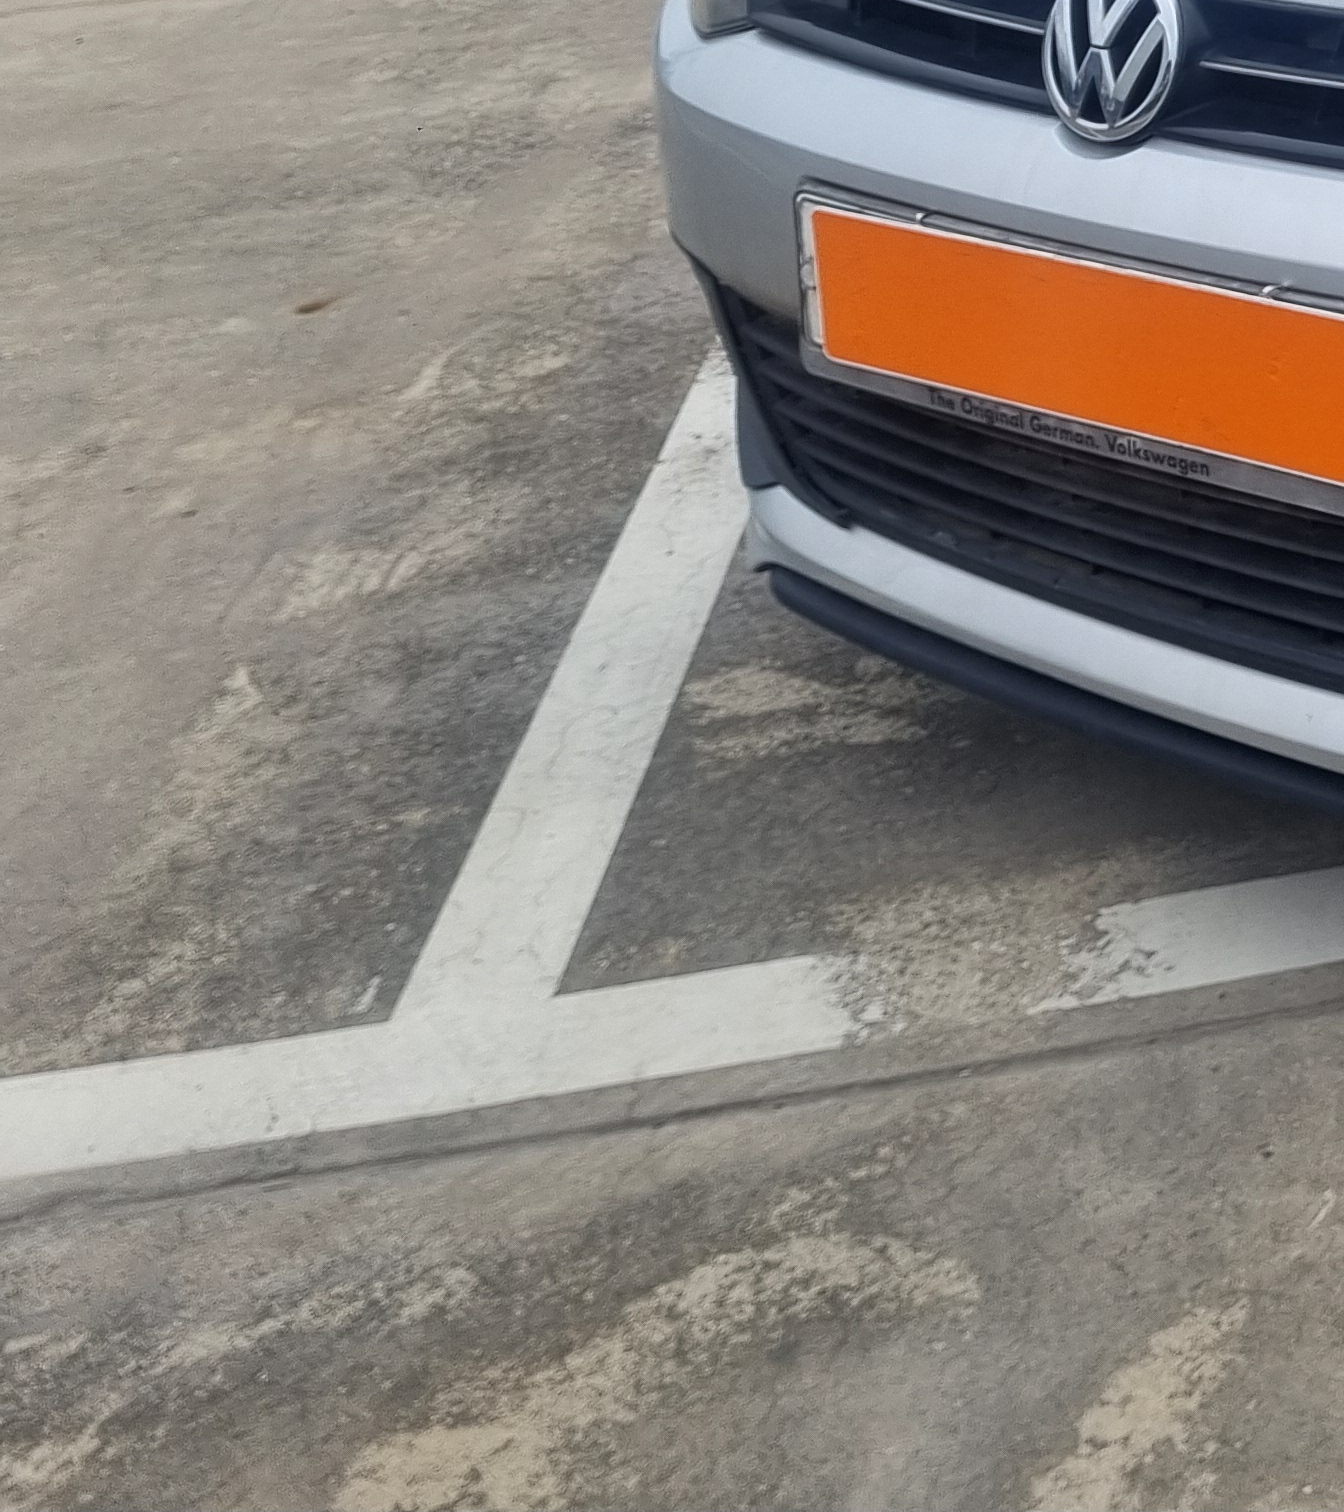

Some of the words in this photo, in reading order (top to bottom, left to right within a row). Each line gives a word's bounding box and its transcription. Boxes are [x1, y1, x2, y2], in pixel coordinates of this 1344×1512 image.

[928, 388, 955, 411] The
[960, 395, 1025, 429] Original
[1104, 434, 1210, 476] Volkswagen
